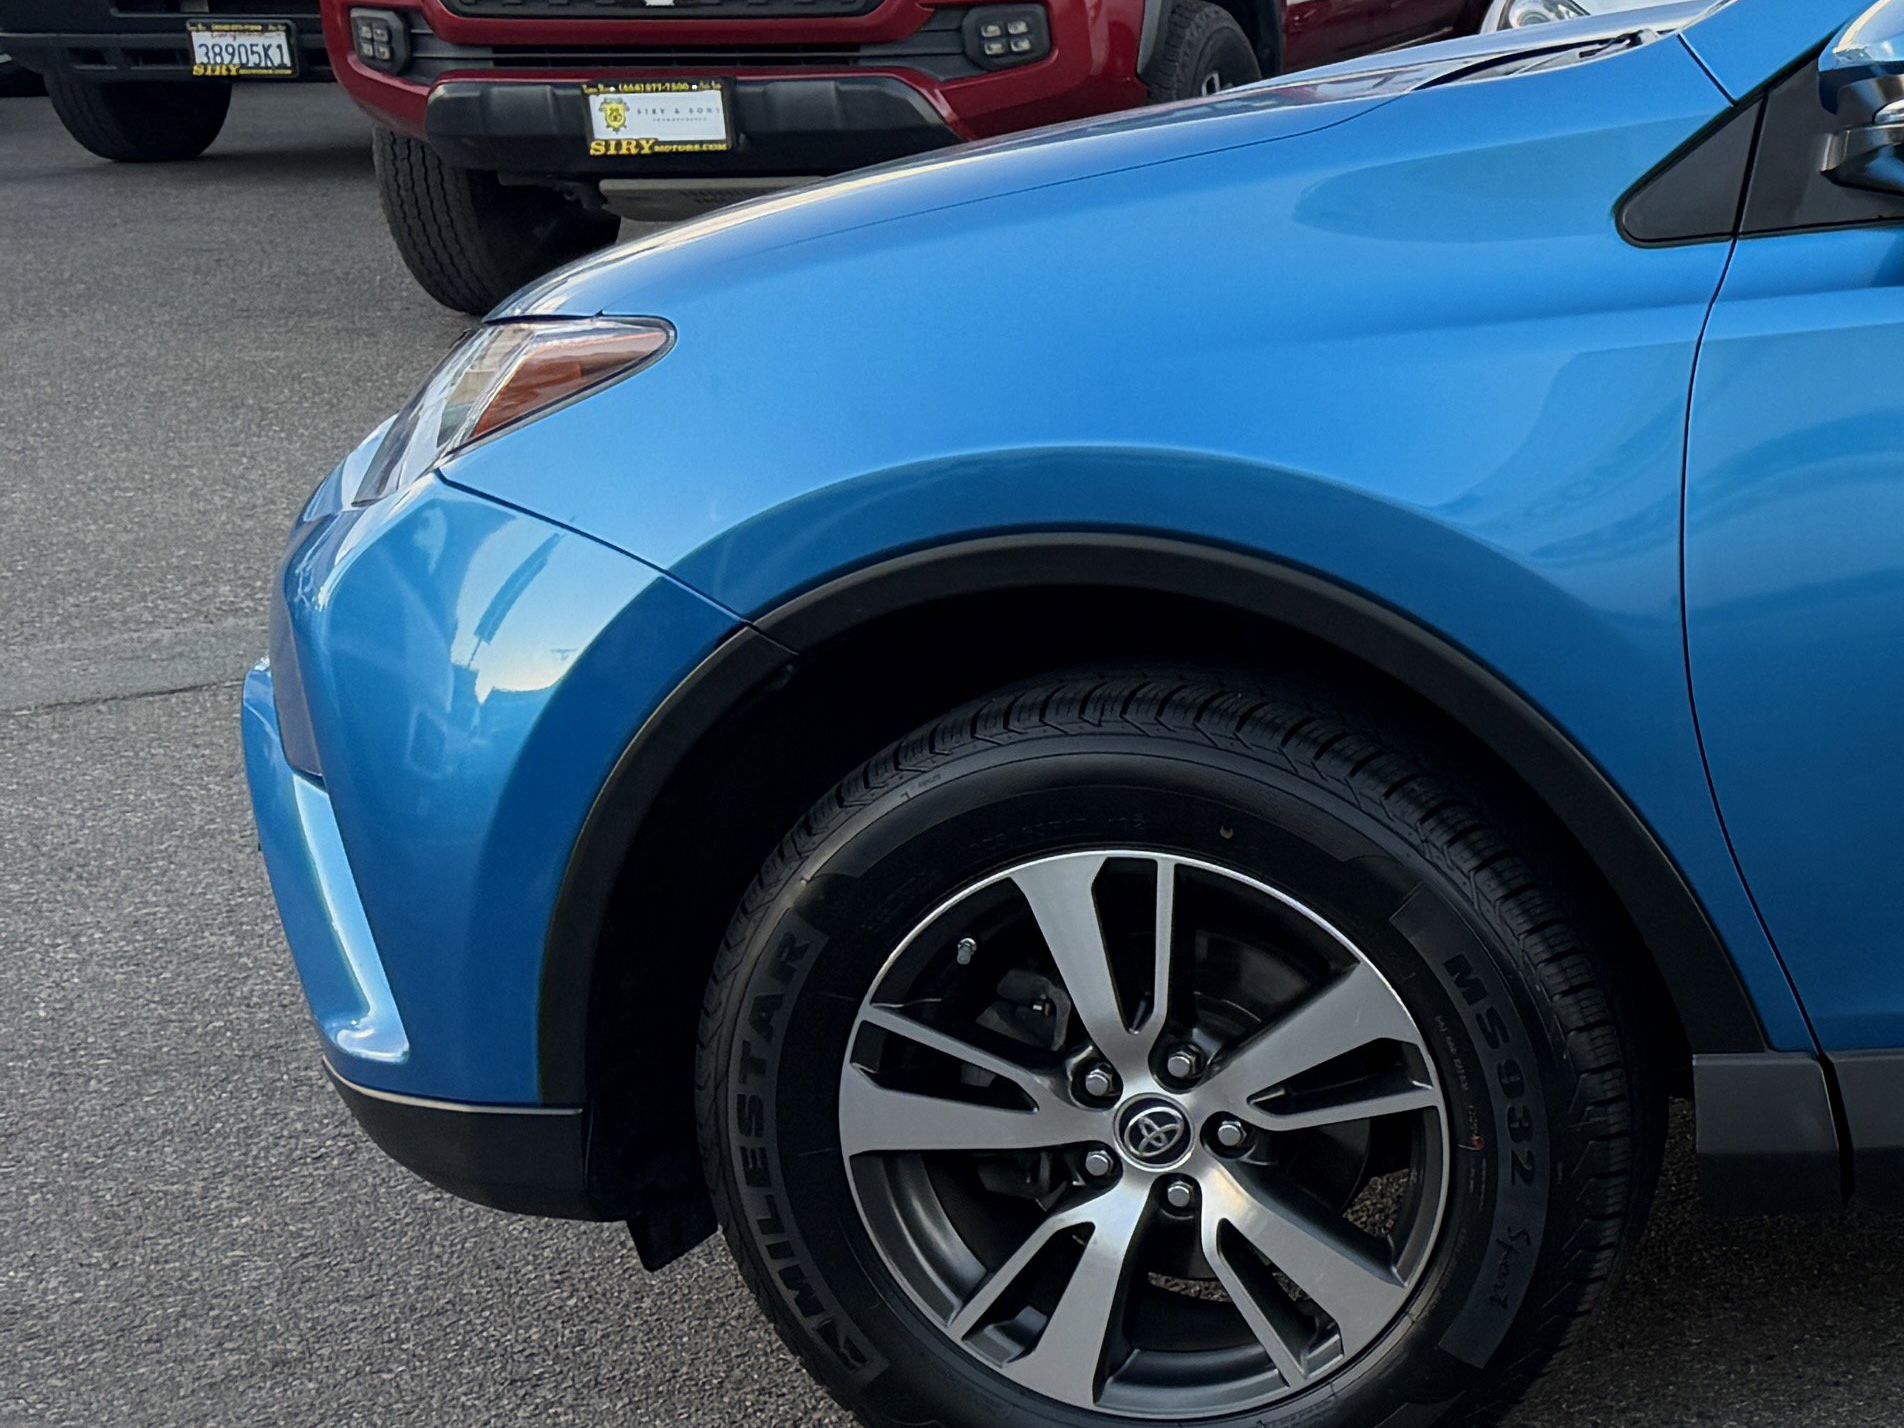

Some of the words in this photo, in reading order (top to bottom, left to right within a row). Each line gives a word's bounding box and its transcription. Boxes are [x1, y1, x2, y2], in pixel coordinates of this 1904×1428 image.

[198, 44, 288, 70] 38905K1
[734, 929, 826, 1320] MILESTAR
[1440, 953, 1537, 1187] MS932
[1488, 1225, 1533, 1311] Sport
